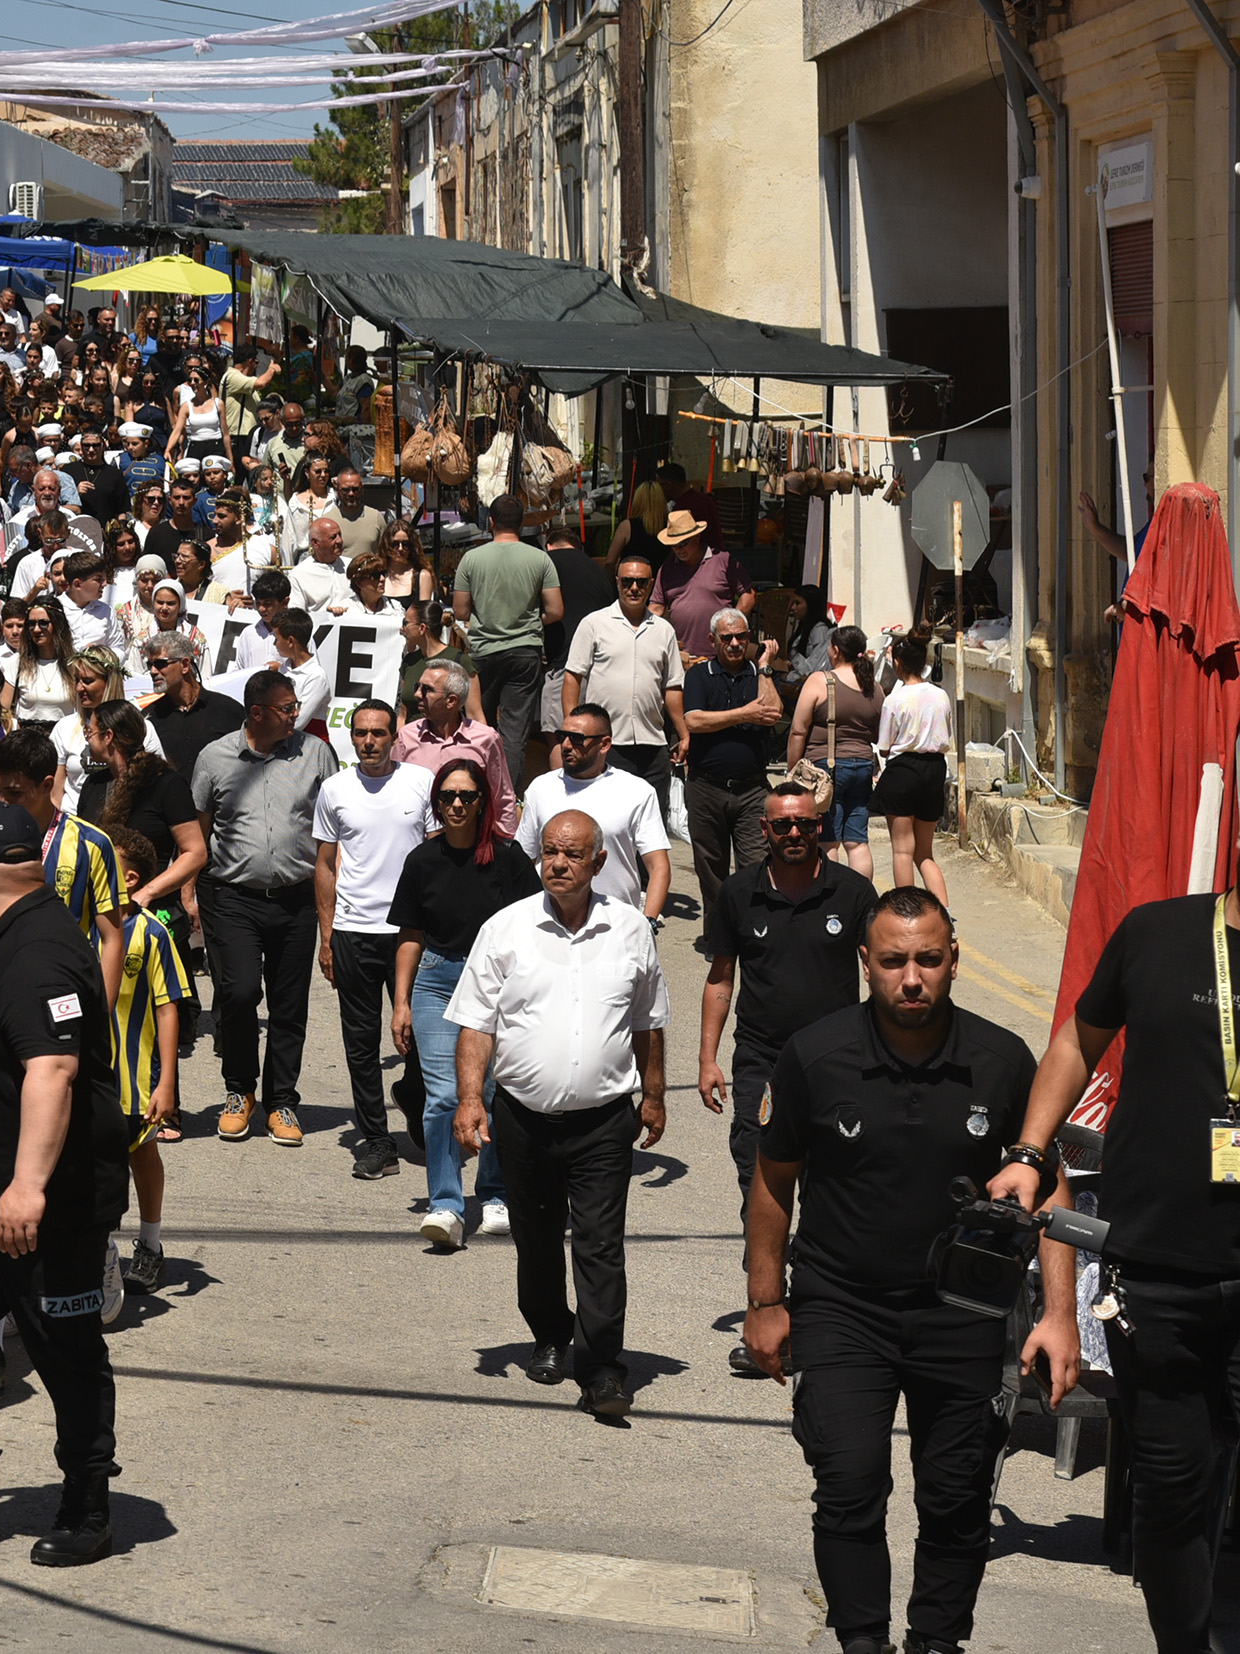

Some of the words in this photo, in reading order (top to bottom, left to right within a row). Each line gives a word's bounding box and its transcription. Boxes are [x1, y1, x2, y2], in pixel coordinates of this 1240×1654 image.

[1215, 930, 1227, 984] KOMİSYONU
[1221, 986, 1229, 1014] KARTI
[1223, 1017, 1232, 1045] BASIN
[47, 1294, 100, 1314] ZABITA
